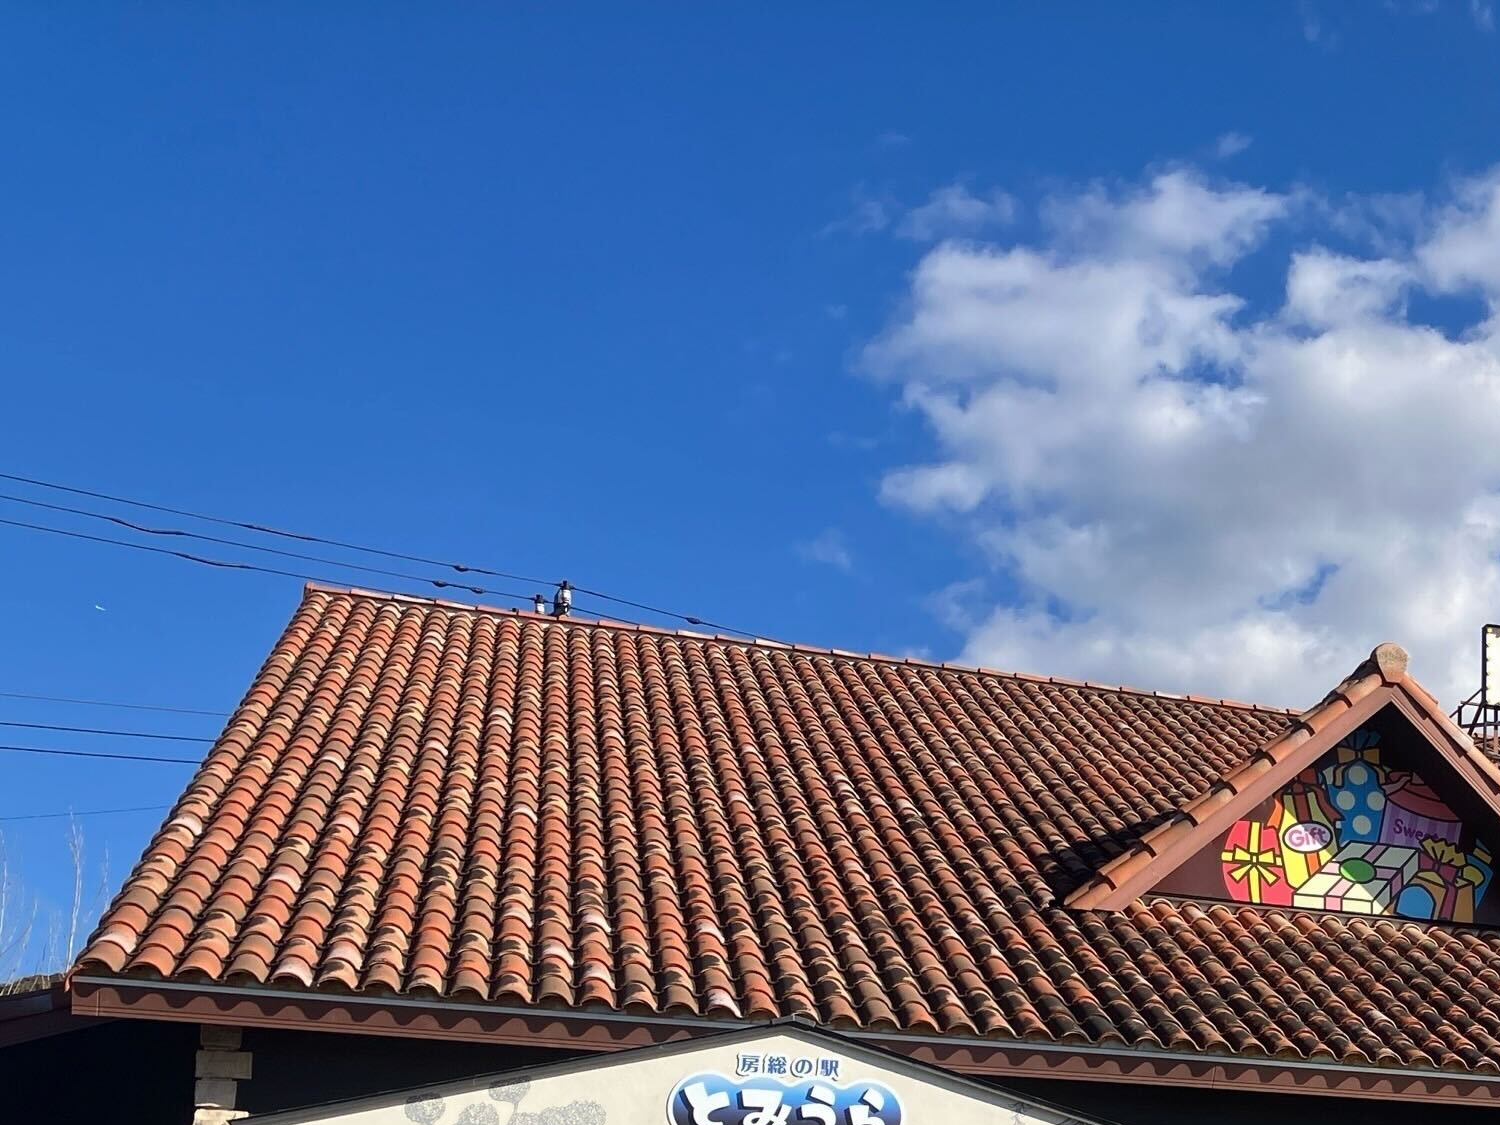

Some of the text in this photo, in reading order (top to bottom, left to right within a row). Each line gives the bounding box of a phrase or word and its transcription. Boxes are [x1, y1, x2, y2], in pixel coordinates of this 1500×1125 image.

[1287, 825, 1328, 848] Gift
[740, 1054, 840, 1078] 房総の駅
